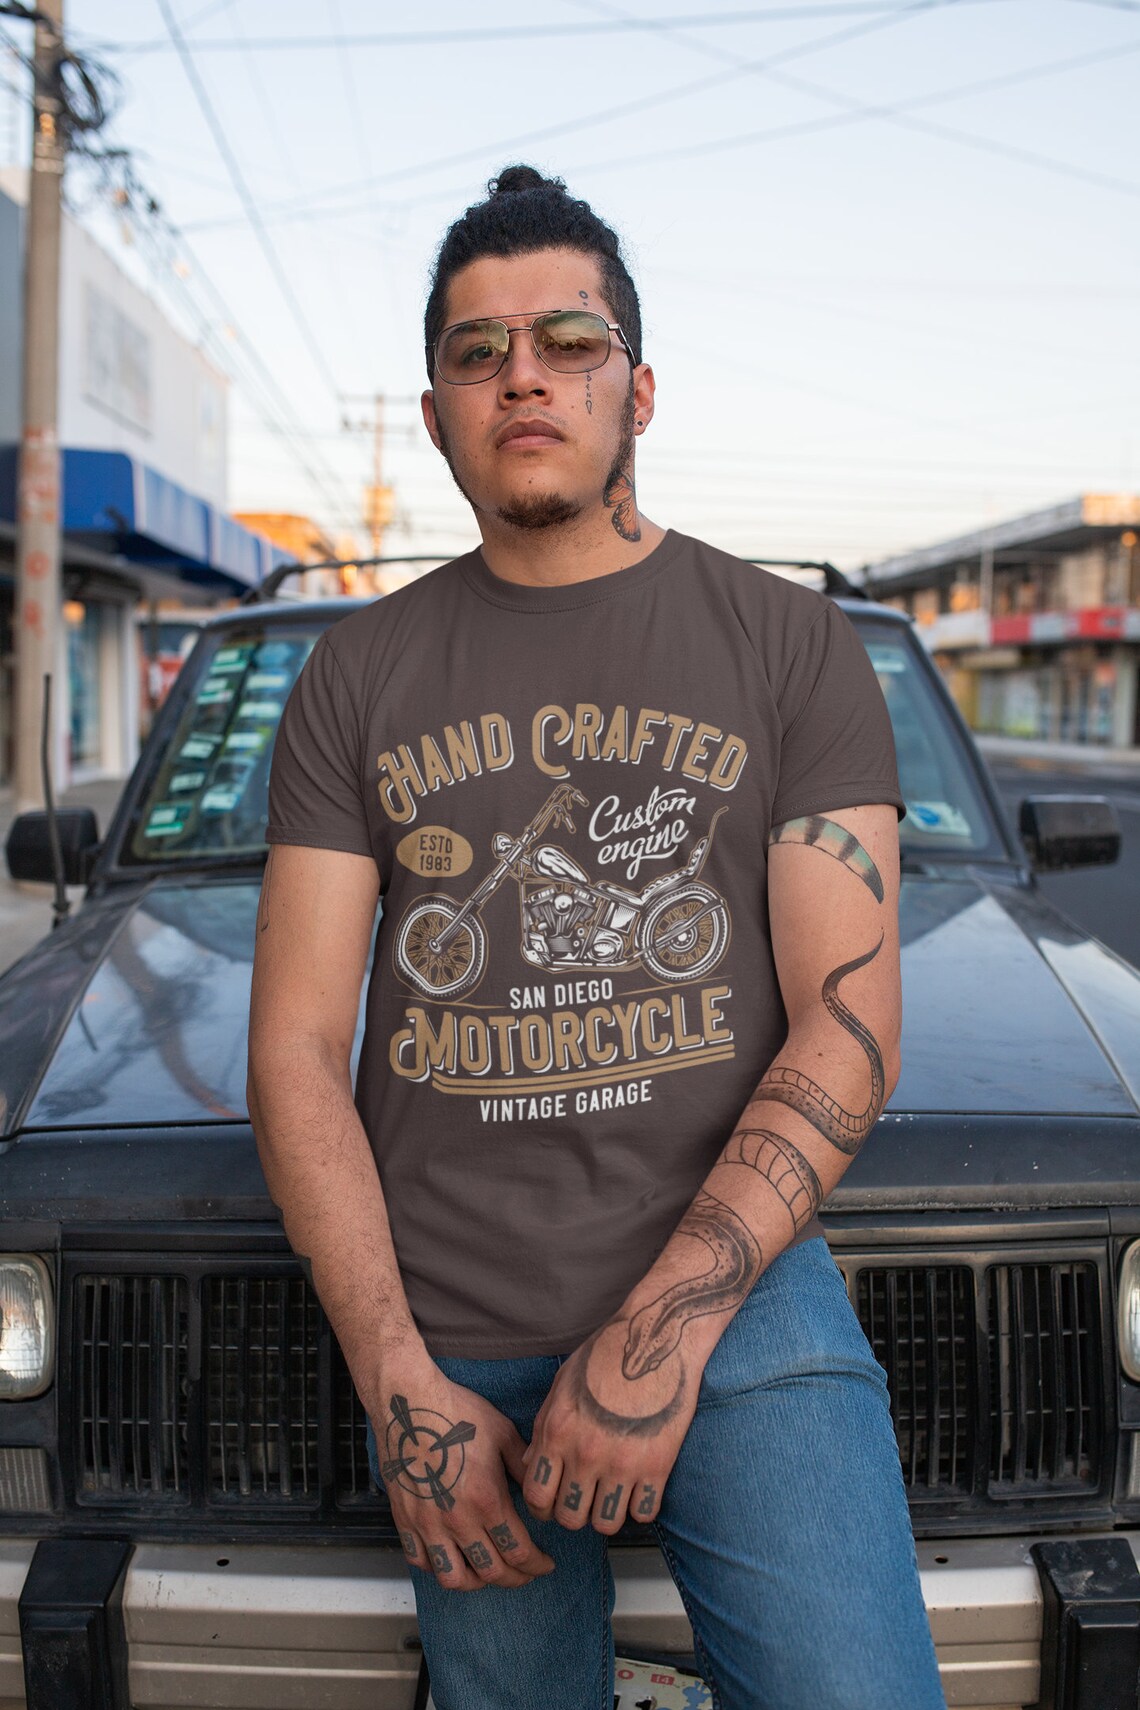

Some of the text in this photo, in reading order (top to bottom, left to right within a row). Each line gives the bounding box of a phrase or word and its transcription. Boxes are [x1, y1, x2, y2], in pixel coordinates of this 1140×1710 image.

[377, 704, 749, 824] HAND CRAFTED
[588, 785, 697, 842] Custom
[419, 834, 453, 854] ESTD
[419, 854, 452, 872] 1983
[597, 819, 689, 880] engine
[509, 978, 613, 1010] SAN DIEGO
[389, 985, 735, 1082] MOTORCYCLE
[479, 1080, 652, 1122] VINTAGE GARAGE
